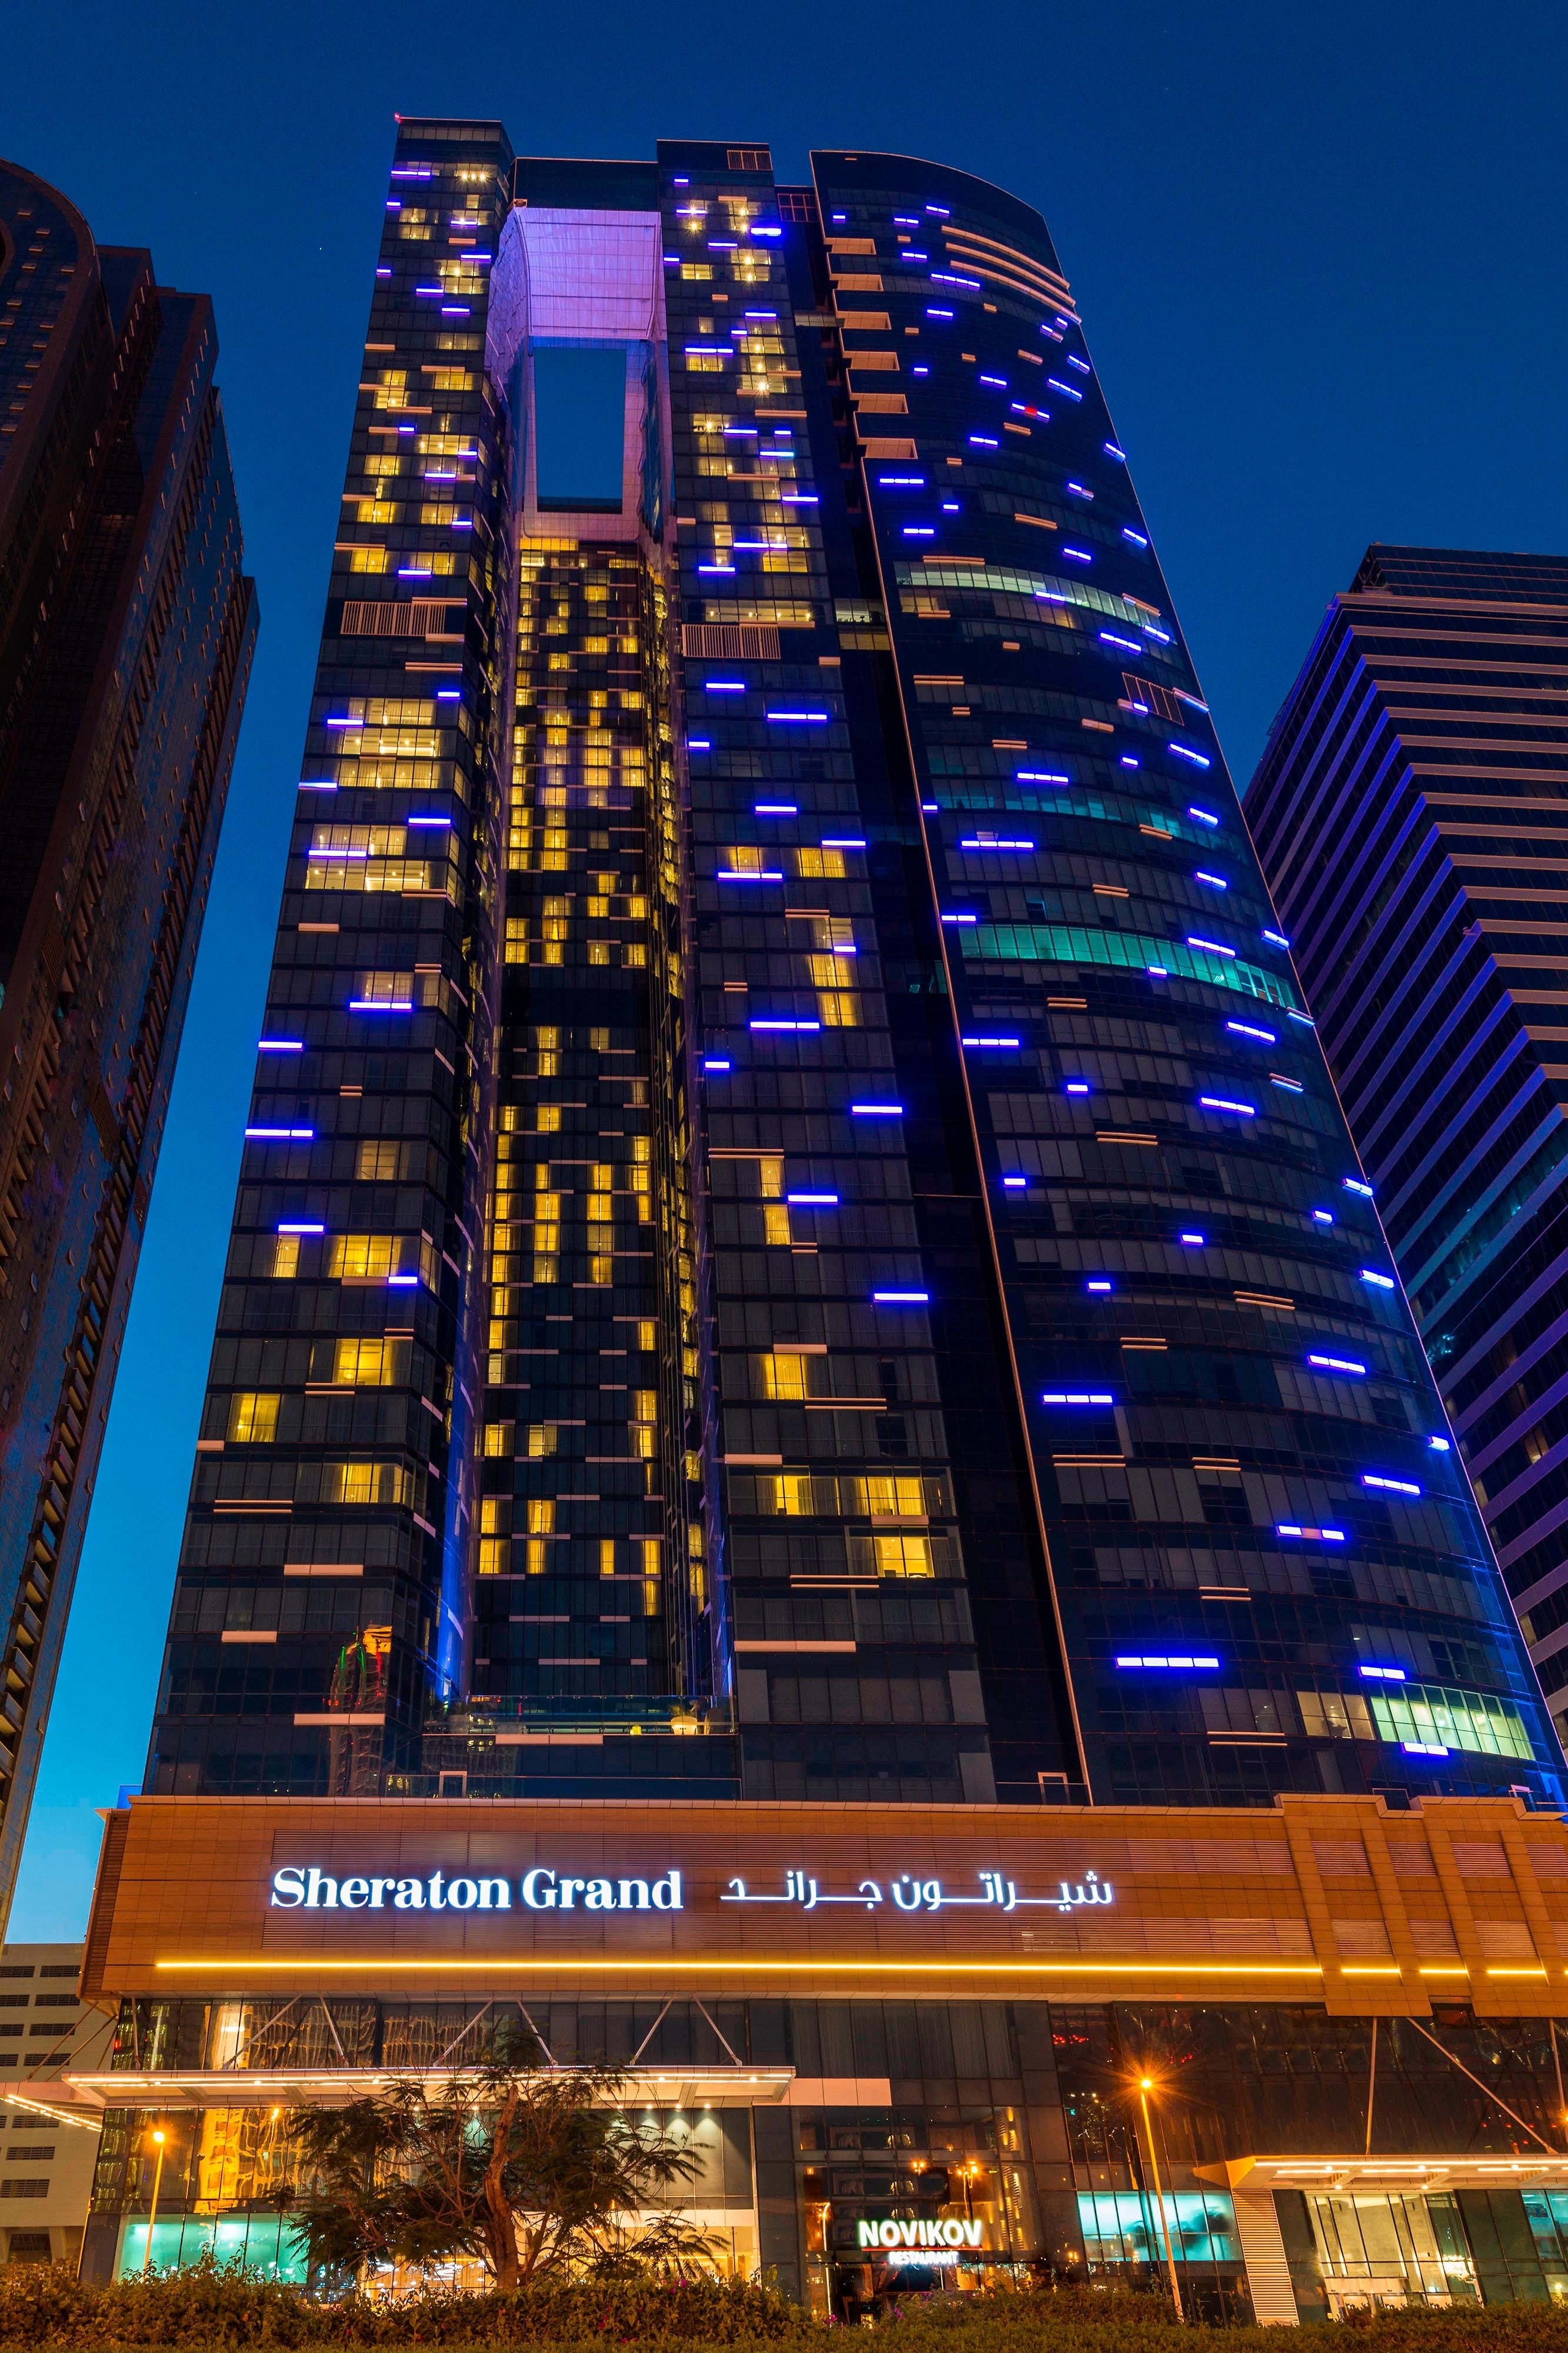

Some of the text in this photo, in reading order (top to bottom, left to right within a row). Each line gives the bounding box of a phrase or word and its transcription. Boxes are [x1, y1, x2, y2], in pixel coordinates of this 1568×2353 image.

[271, 1867, 683, 1909] Sheraton Grand
[719, 1870, 1113, 1911] شيراتون جراند
[859, 2219, 982, 2247] NOVIKOV
[889, 2251, 959, 2265] RESTAURANT
